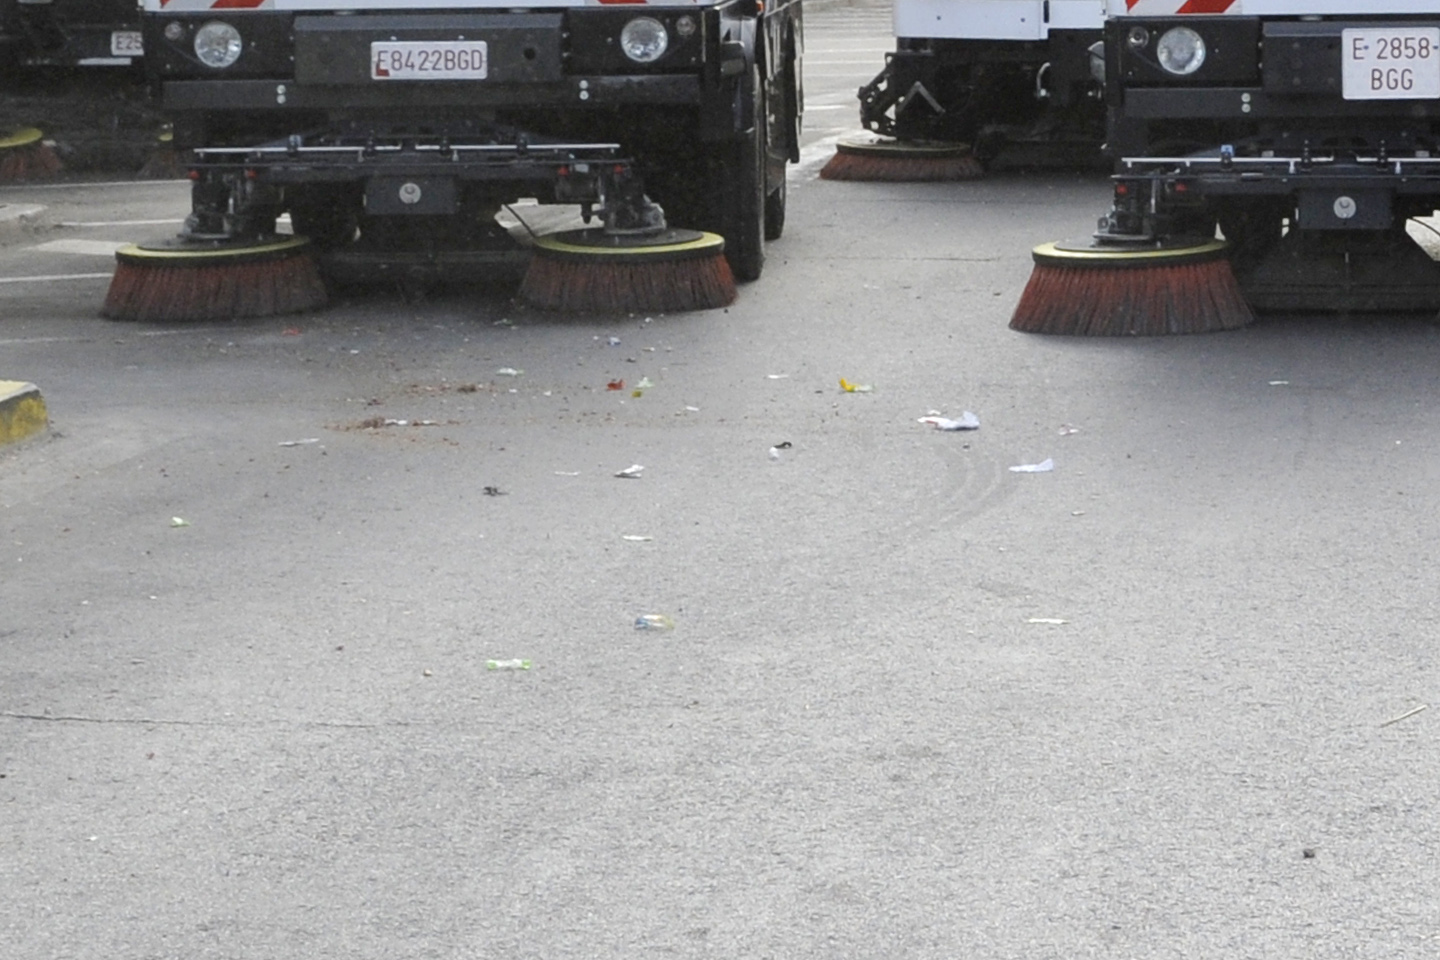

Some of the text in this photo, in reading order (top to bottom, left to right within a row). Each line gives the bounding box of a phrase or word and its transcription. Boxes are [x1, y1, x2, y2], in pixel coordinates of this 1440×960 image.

[1353, 37, 1430, 60] E 2858
[377, 49, 483, 71] E8422BGD
[1371, 68, 1413, 90] BGG
